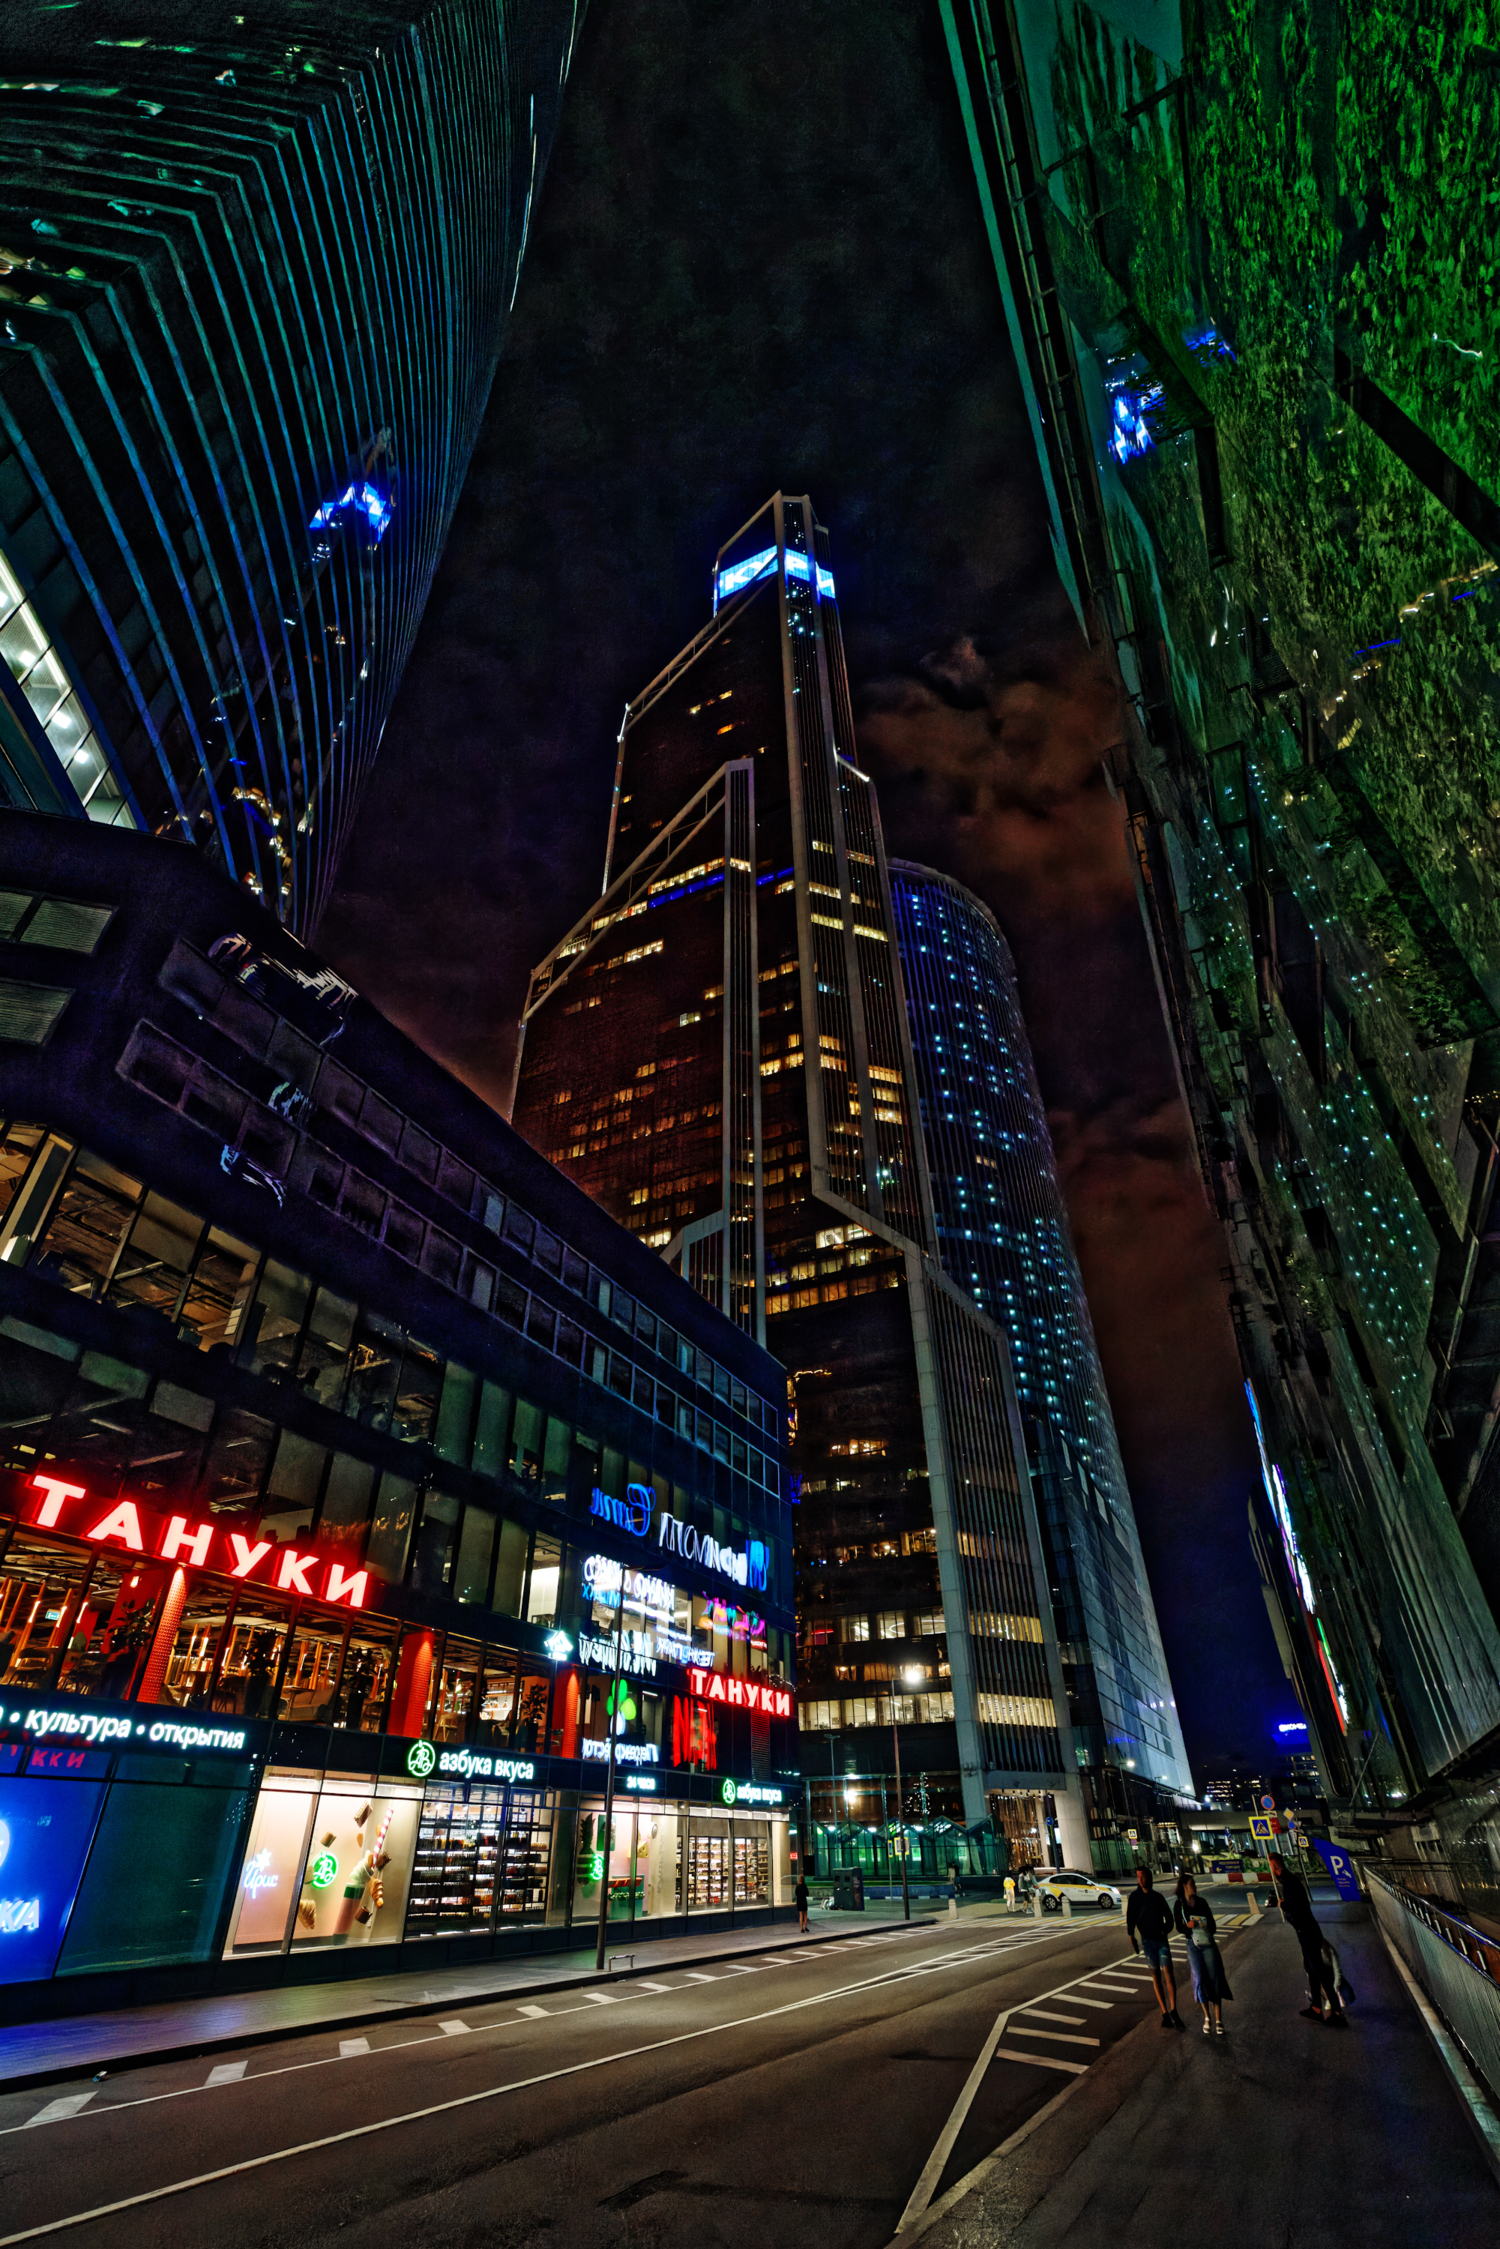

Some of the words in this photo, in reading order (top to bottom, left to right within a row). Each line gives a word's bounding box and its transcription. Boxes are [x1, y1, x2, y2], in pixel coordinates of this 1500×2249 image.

[31, 1474, 369, 1608] ТАНУКИ
[687, 1668, 790, 1716] ТАНУКИ
[24, 1709, 131, 1742] культура
[149, 1722, 246, 1749] открытия
[439, 1749, 493, 1779] азбука
[494, 1758, 535, 1783] вкуса
[626, 1775, 637, 1790] 24
[736, 1783, 762, 1803] азбука
[762, 1786, 783, 1805] вкуса
